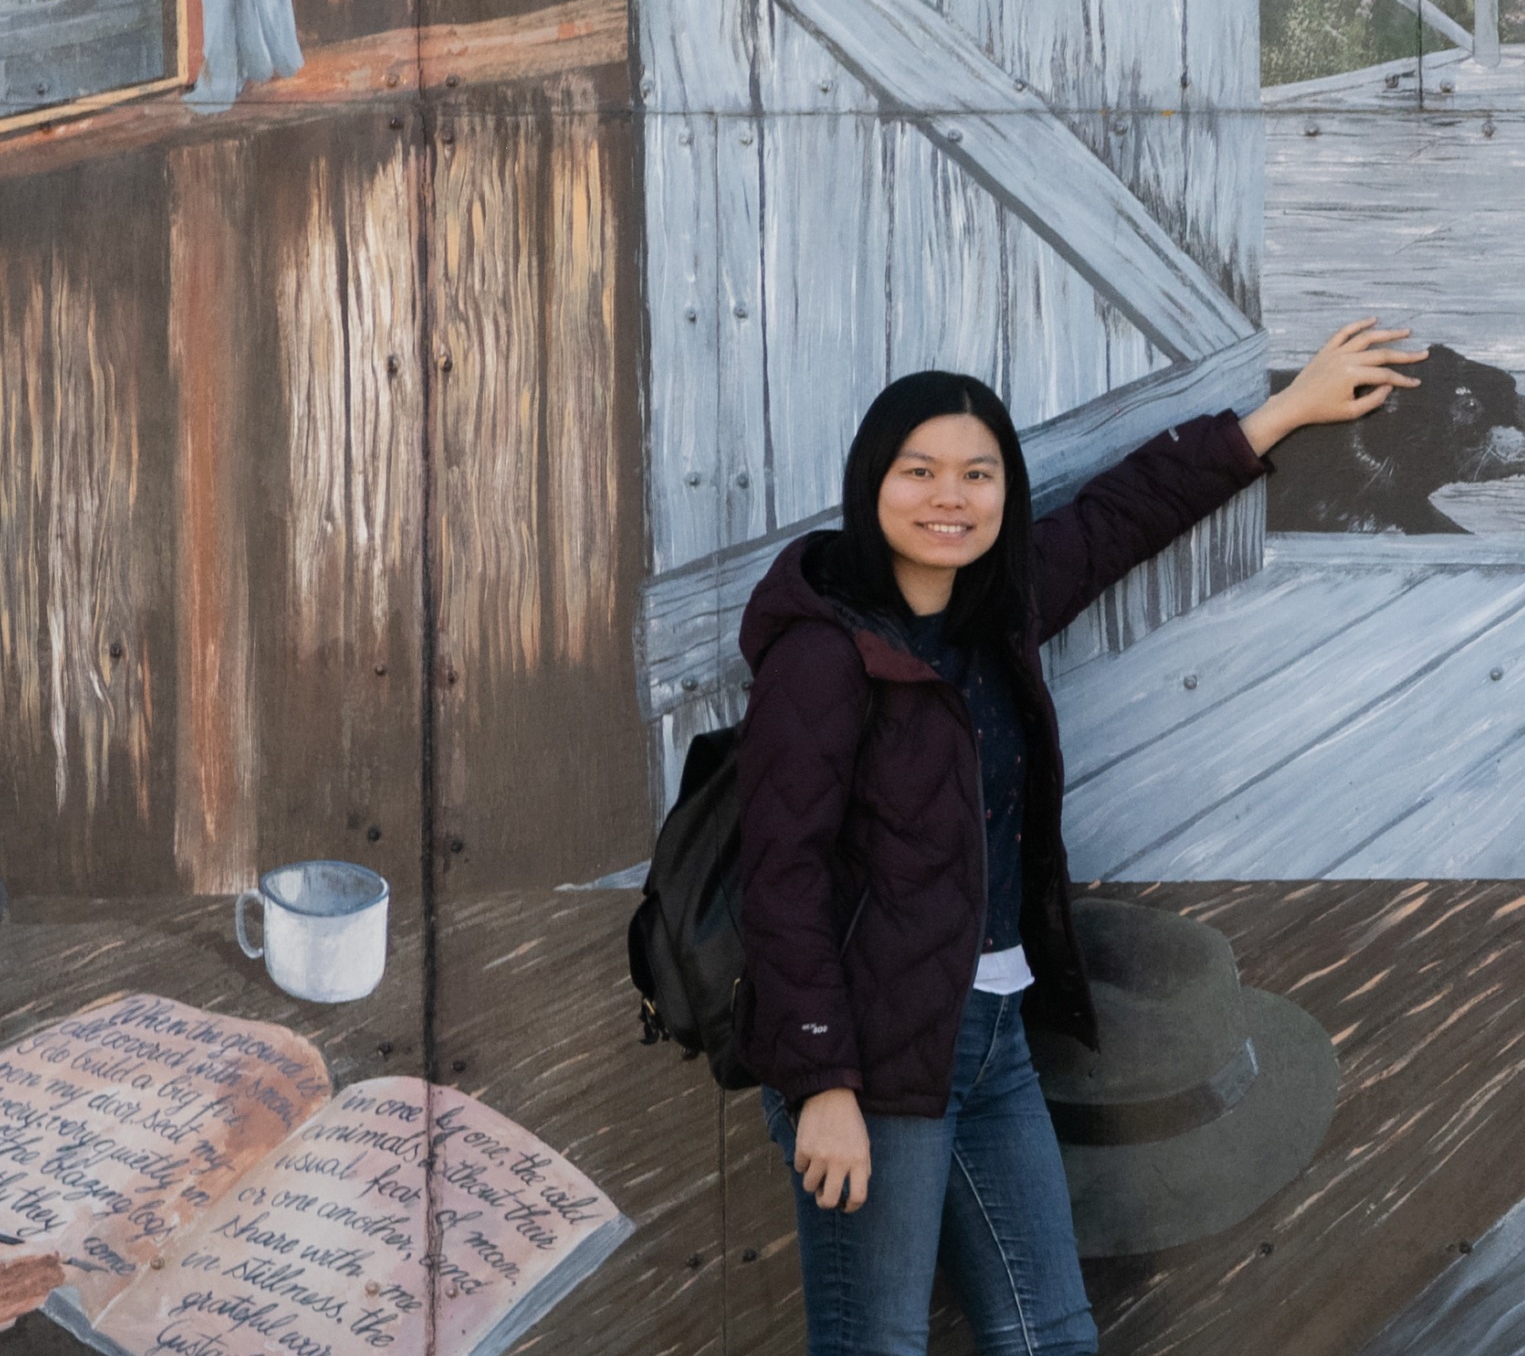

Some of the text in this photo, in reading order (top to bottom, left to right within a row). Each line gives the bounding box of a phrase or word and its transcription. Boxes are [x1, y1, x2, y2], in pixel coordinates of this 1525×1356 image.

[40, 1041, 71, 1063] do
[71, 1047, 145, 1083] build
[131, 1074, 153, 1090] a
[157, 1075, 203, 1117] big
[60, 1018, 106, 1042] all
[101, 1031, 196, 1069] covered
[187, 1058, 247, 1087] with
[109, 997, 188, 1035] When
[185, 1017, 224, 1044] the
[208, 1032, 307, 1078] ground
[45, 1078, 93, 1111] my
[135, 1109, 203, 1144] seat
[41, 1151, 132, 1220] blazing
[46, 1116, 100, 1152] very
[84, 1139, 190, 1192] quietly
[180, 1185, 211, 1207] in
[274, 1150, 368, 1180] usual
[355, 1164, 422, 1206] fear
[435, 1210, 483, 1234] of
[302, 1123, 427, 1163] animals
[505, 1199, 558, 1250] their
[342, 1089, 376, 1113] in
[375, 1100, 423, 1123] one
[433, 1106, 470, 1145] by
[510, 1151, 552, 1186] the
[540, 1186, 602, 1225] wild
[11, 1186, 67, 1237] they
[84, 1237, 136, 1276] come
[210, 1211, 423, 1313] share with me
[237, 1187, 267, 1206] or
[271, 1190, 319, 1213] one
[418, 1253, 494, 1295] and
[168, 1290, 299, 1336] grateful
[181, 1246, 220, 1272] in
[350, 1307, 398, 1348] the
